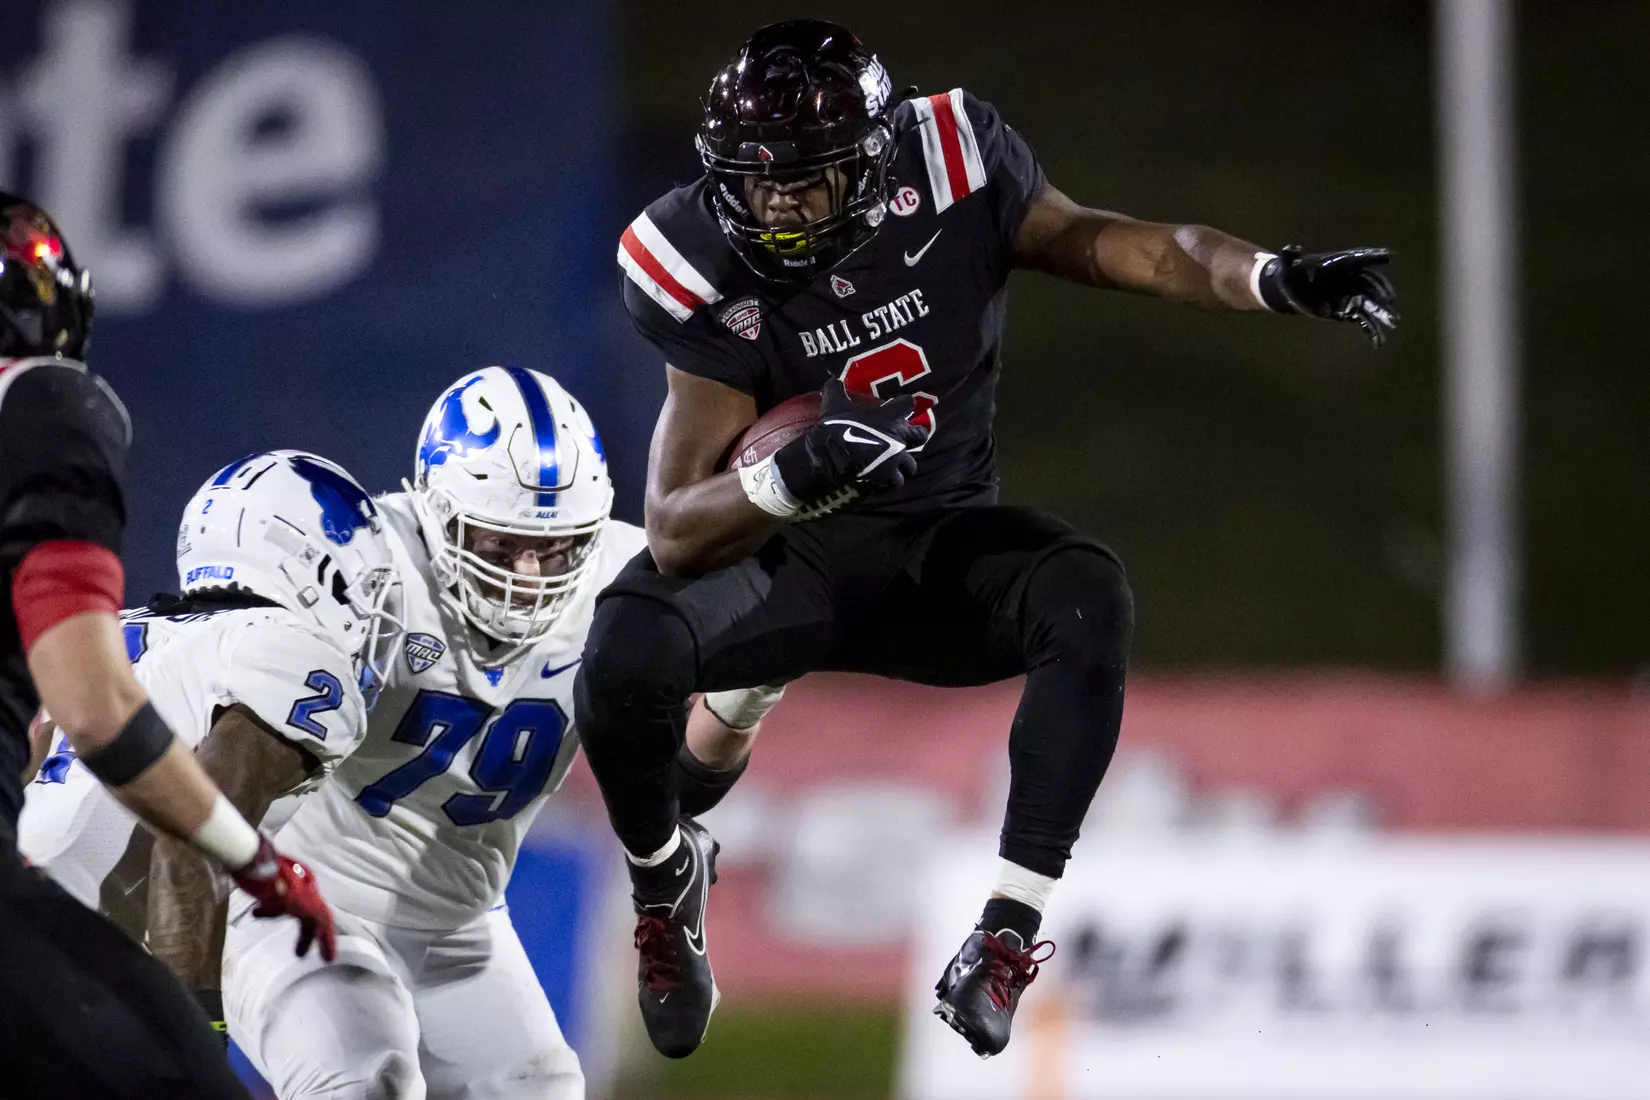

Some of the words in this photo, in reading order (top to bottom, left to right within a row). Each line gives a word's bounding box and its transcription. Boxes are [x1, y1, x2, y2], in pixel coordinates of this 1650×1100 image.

[731, 313, 763, 335] MAC
[799, 320, 861, 358] BALL
[862, 289, 930, 340] STATE
[202, 499, 213, 515] 2
[186, 566, 235, 585] BUFFALO
[406, 642, 441, 661] MAC
[286, 669, 344, 742] 2
[355, 689, 570, 827] 79
